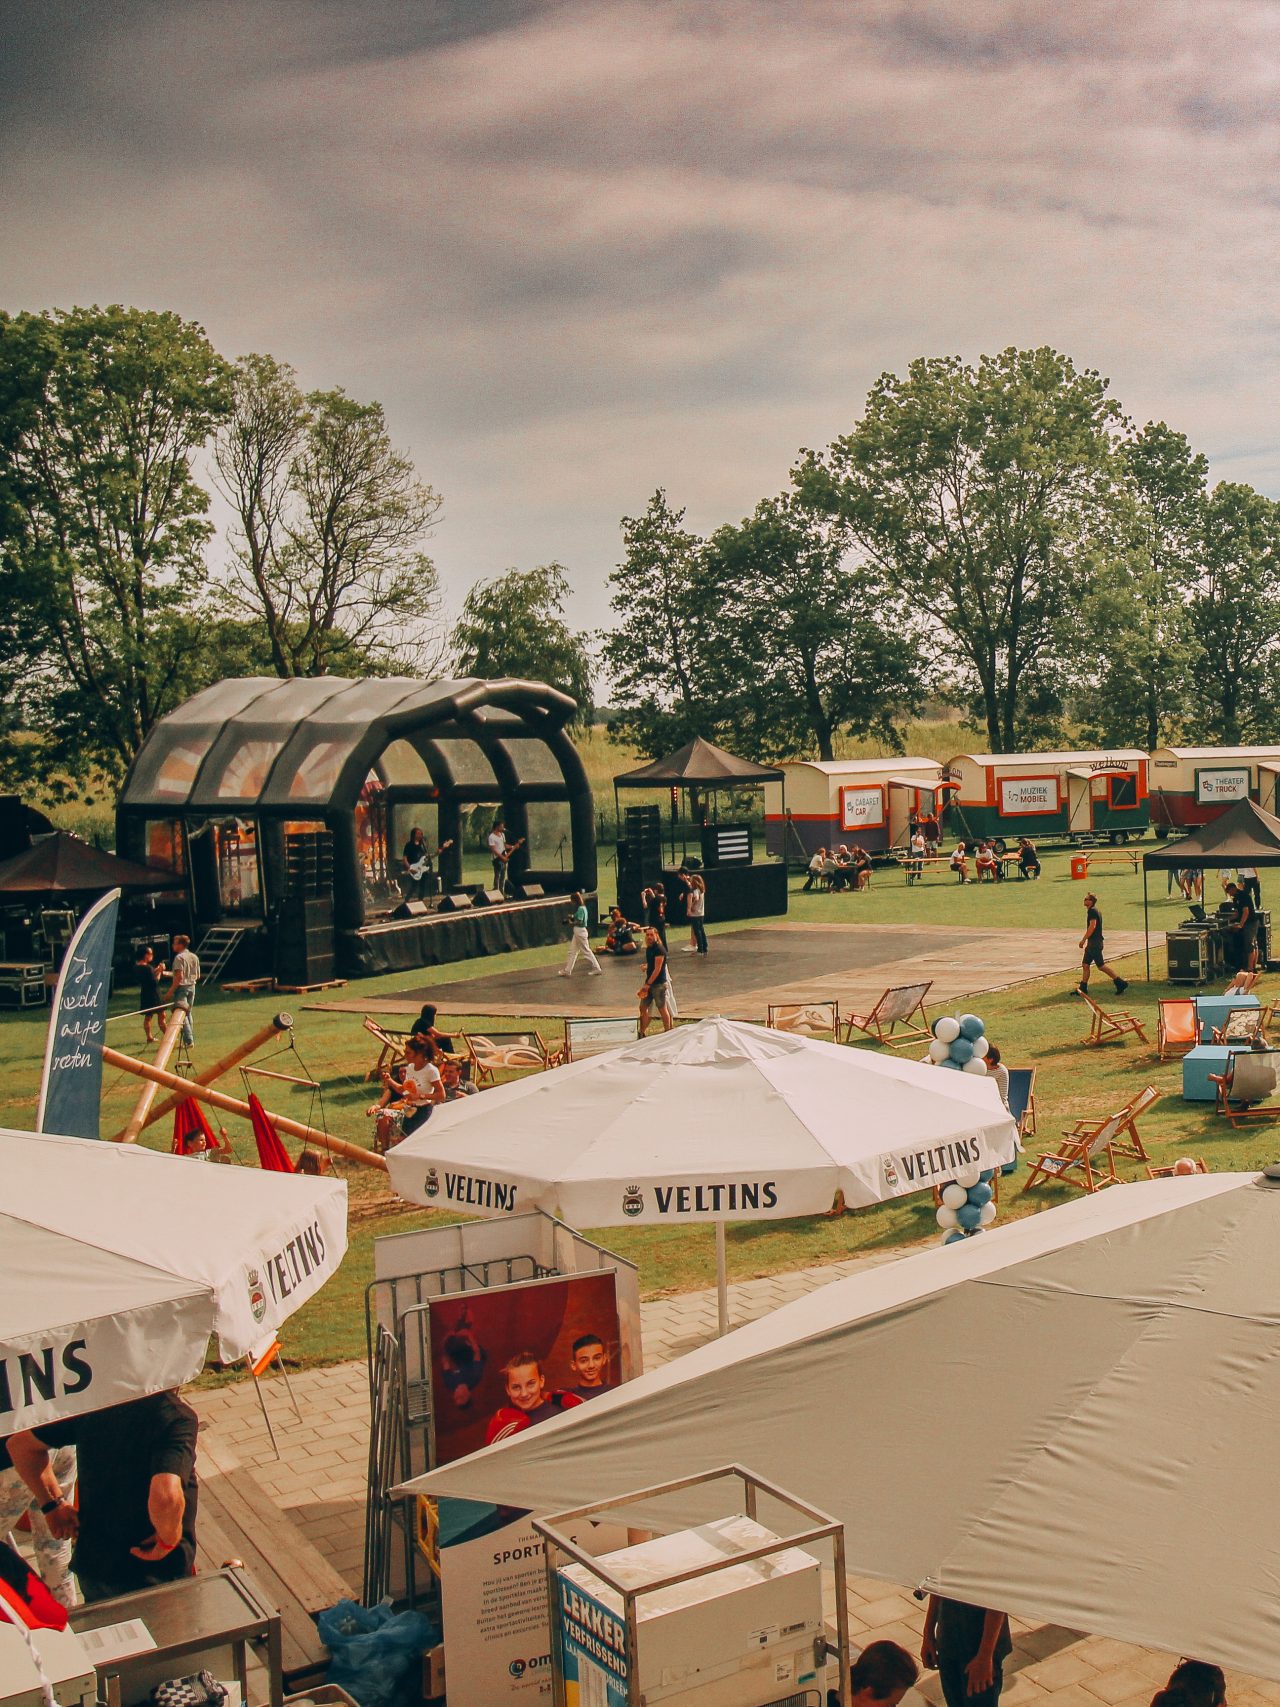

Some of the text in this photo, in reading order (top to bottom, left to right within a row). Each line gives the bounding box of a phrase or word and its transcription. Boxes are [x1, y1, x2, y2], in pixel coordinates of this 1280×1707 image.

[1089, 756, 1129, 772] welkom
[1020, 786, 1048, 795] MUZIEK
[1020, 795, 1047, 804] MOBIEL
[1215, 785, 1238, 793] TRUCK
[854, 797, 880, 807] CABARET
[855, 807, 867, 816] CAR
[901, 1137, 980, 1181] VELTINS
[445, 1172, 517, 1212] VELTINS
[654, 1182, 778, 1213] VELTINS
[262, 1221, 325, 1305] VELTINS
[0, 1339, 93, 1414] INS
[514, 1570, 537, 1580] sporten
[562, 1583, 626, 1657] LEKKER
[563, 1616, 628, 1678] VERFRISSEND
